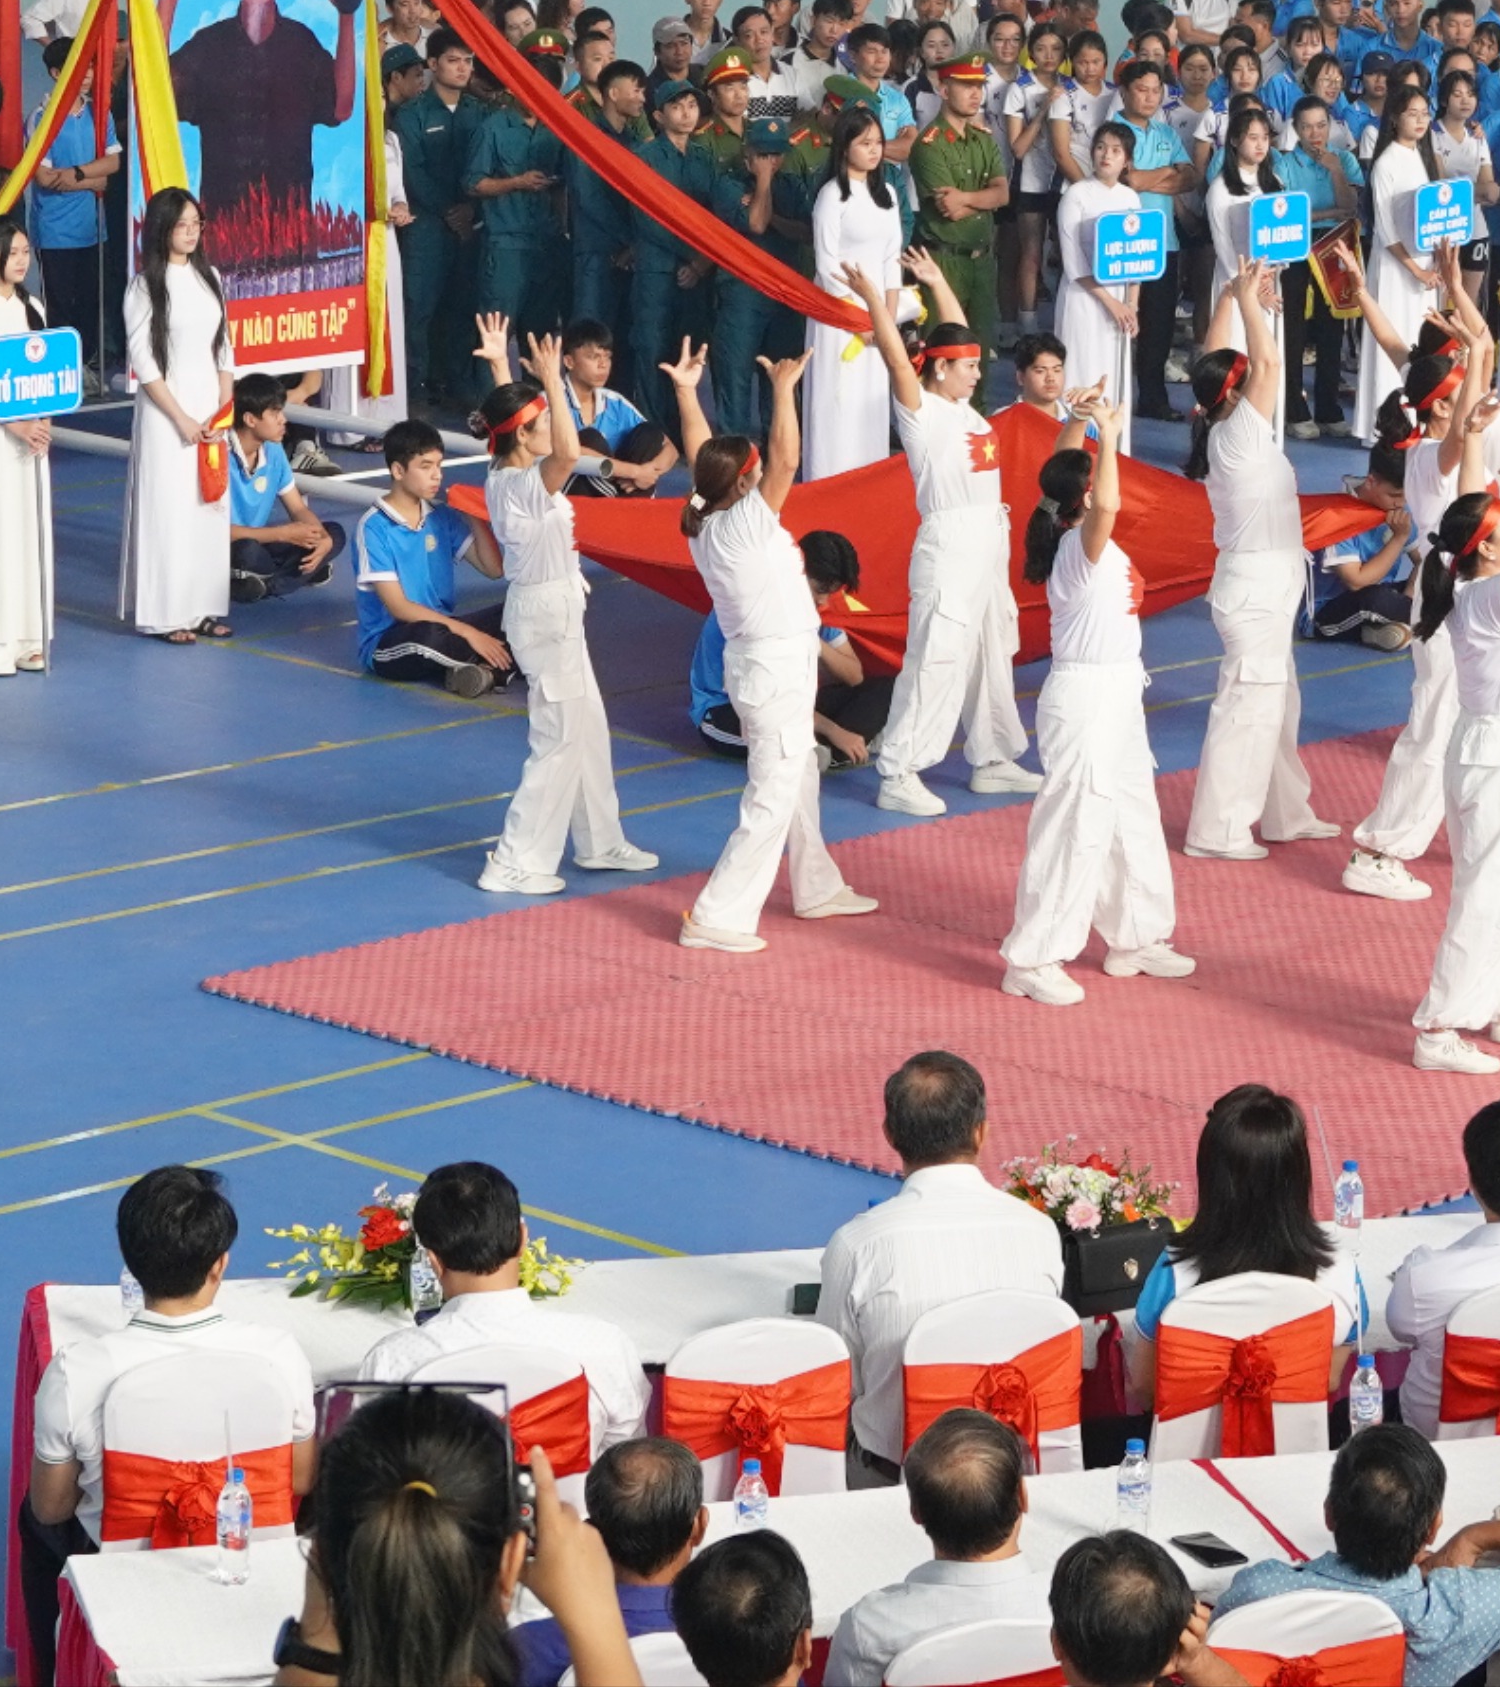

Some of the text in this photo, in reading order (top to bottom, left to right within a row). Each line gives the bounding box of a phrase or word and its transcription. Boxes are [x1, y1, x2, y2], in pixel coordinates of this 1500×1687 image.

[1104, 238, 1157, 258] LỰC LƯỢNG
[1109, 259, 1155, 276] VŨ TRANG
[243, 311, 273, 347] NÀO
[277, 307, 317, 343] CŨNG
[13, 372, 55, 405] TRỌNG
[57, 363, 78, 395] TÀI
